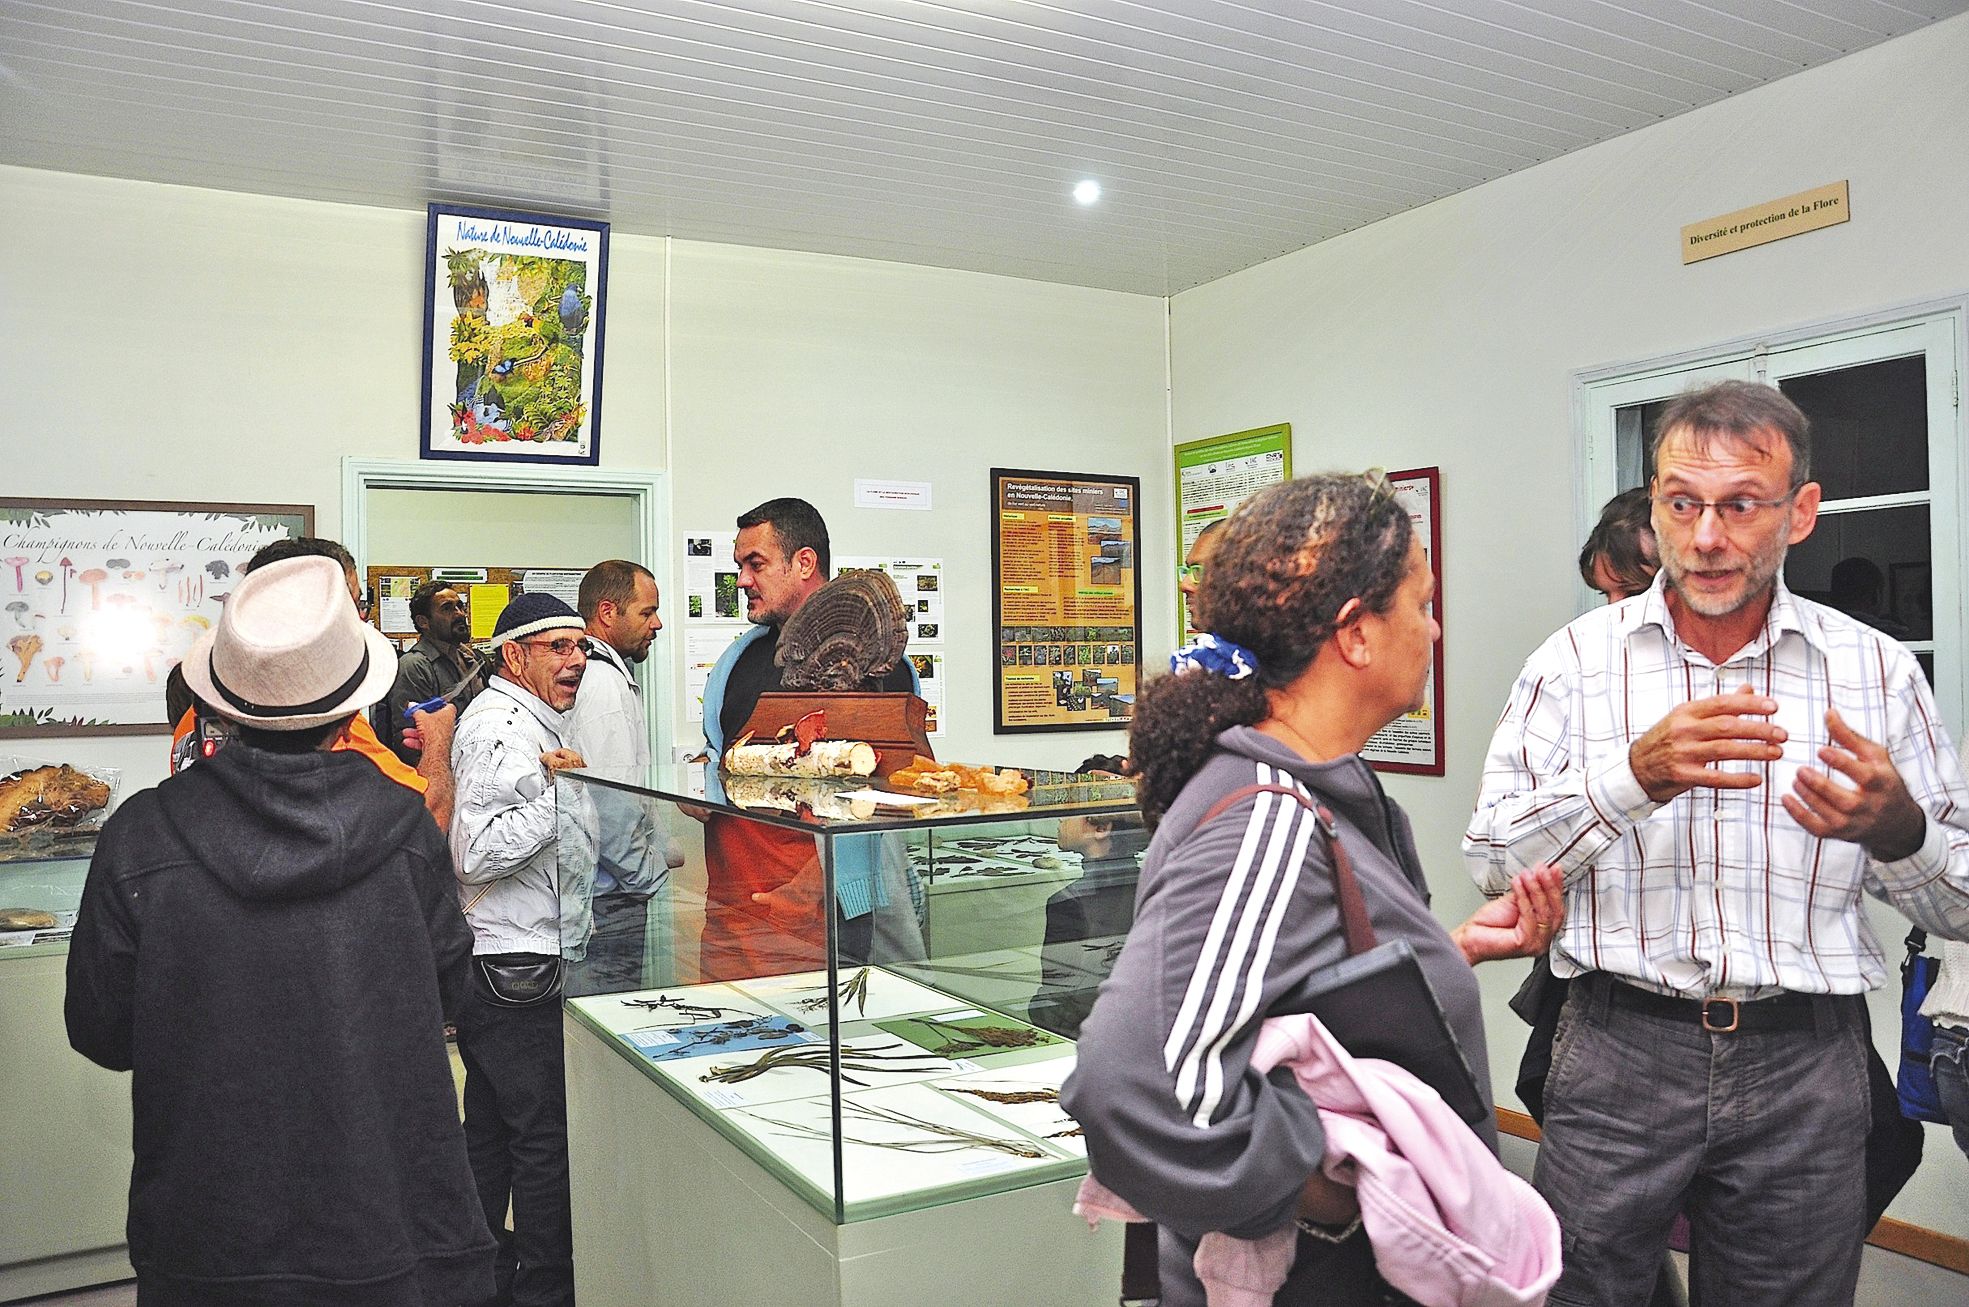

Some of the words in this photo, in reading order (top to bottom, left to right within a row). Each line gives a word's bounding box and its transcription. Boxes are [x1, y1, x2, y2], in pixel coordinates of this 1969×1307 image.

[457, 220, 488, 241] Nature
[490, 224, 500, 243] de
[502, 225, 588, 252] Nouvelle-Calédonie
[1690, 227, 1728, 245] Diversité
[1730, 225, 1738, 234] et
[1740, 213, 1786, 233] protection
[1788, 208, 1799, 218] de
[1801, 205, 1810, 214] la
[1813, 198, 1839, 211] Flore
[4, 526, 97, 563] Champignons
[102, 529, 123, 551] de
